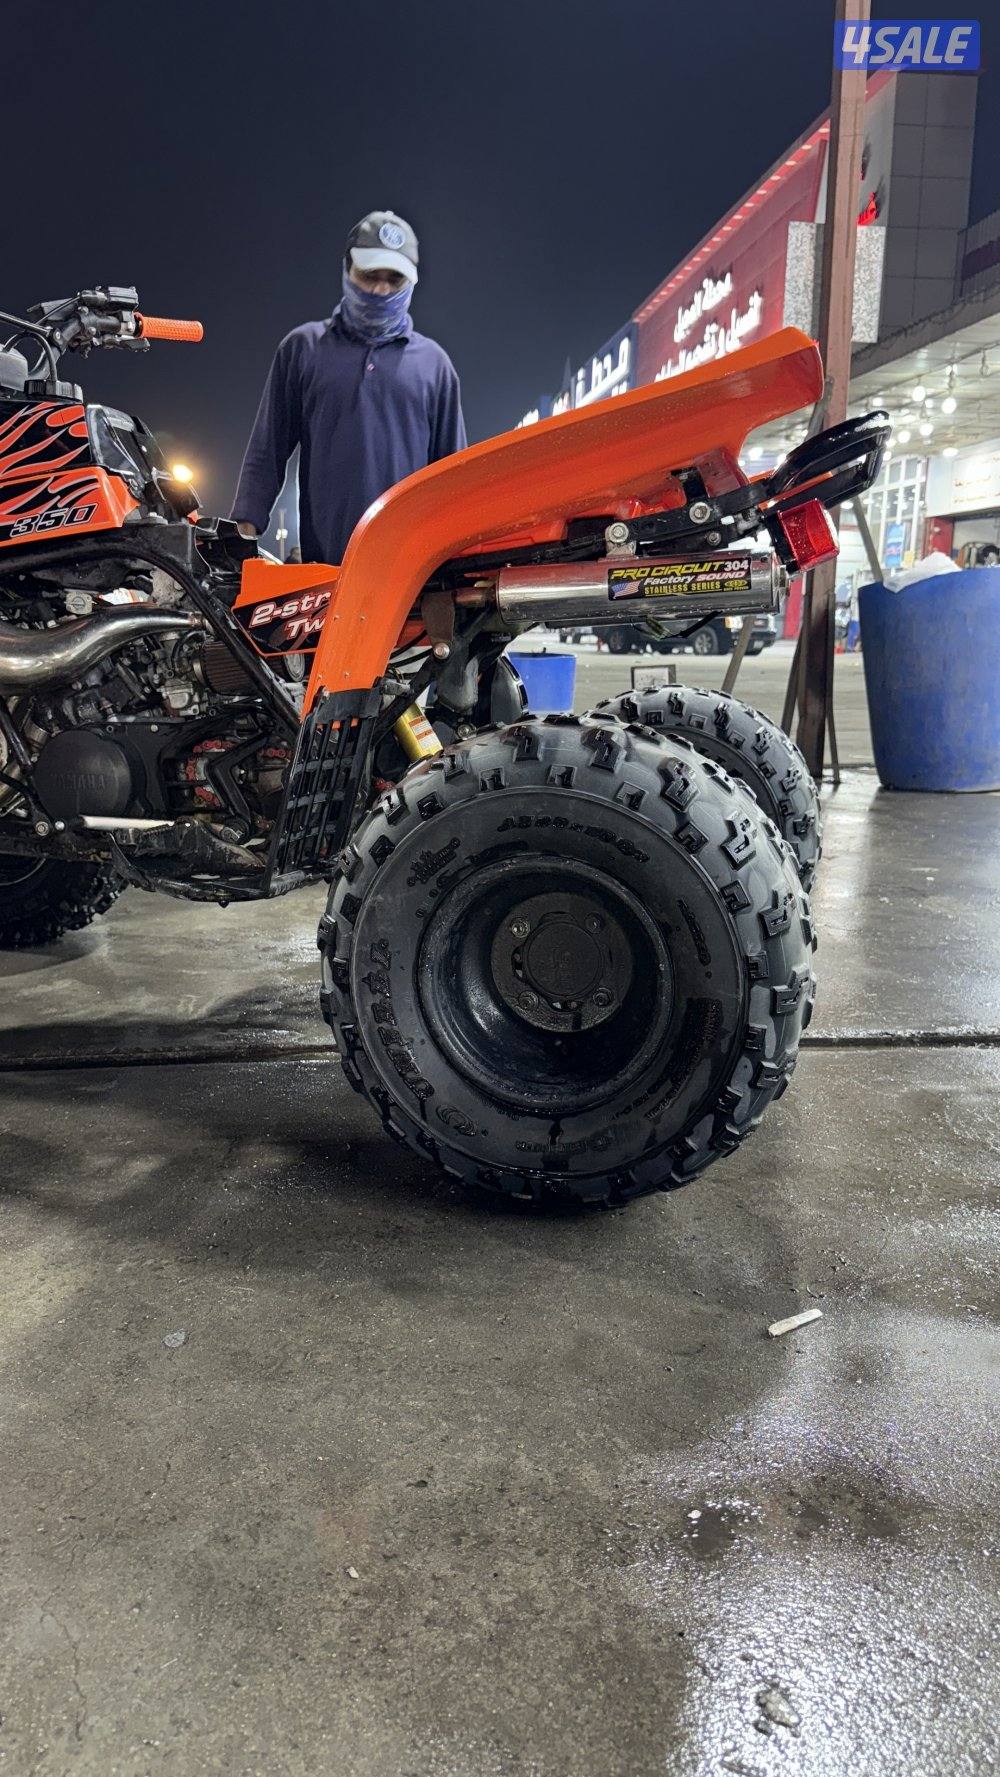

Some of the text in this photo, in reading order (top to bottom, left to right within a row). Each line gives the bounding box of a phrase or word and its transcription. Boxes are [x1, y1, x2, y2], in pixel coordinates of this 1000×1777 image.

[10, 503, 98, 537] 350
[611, 560, 749, 580] PRO CIRCUIT 304
[643, 571, 745, 586] Factory SOUND
[644, 583, 689, 595] STAINLESS
[691, 580, 721, 591] SERIES
